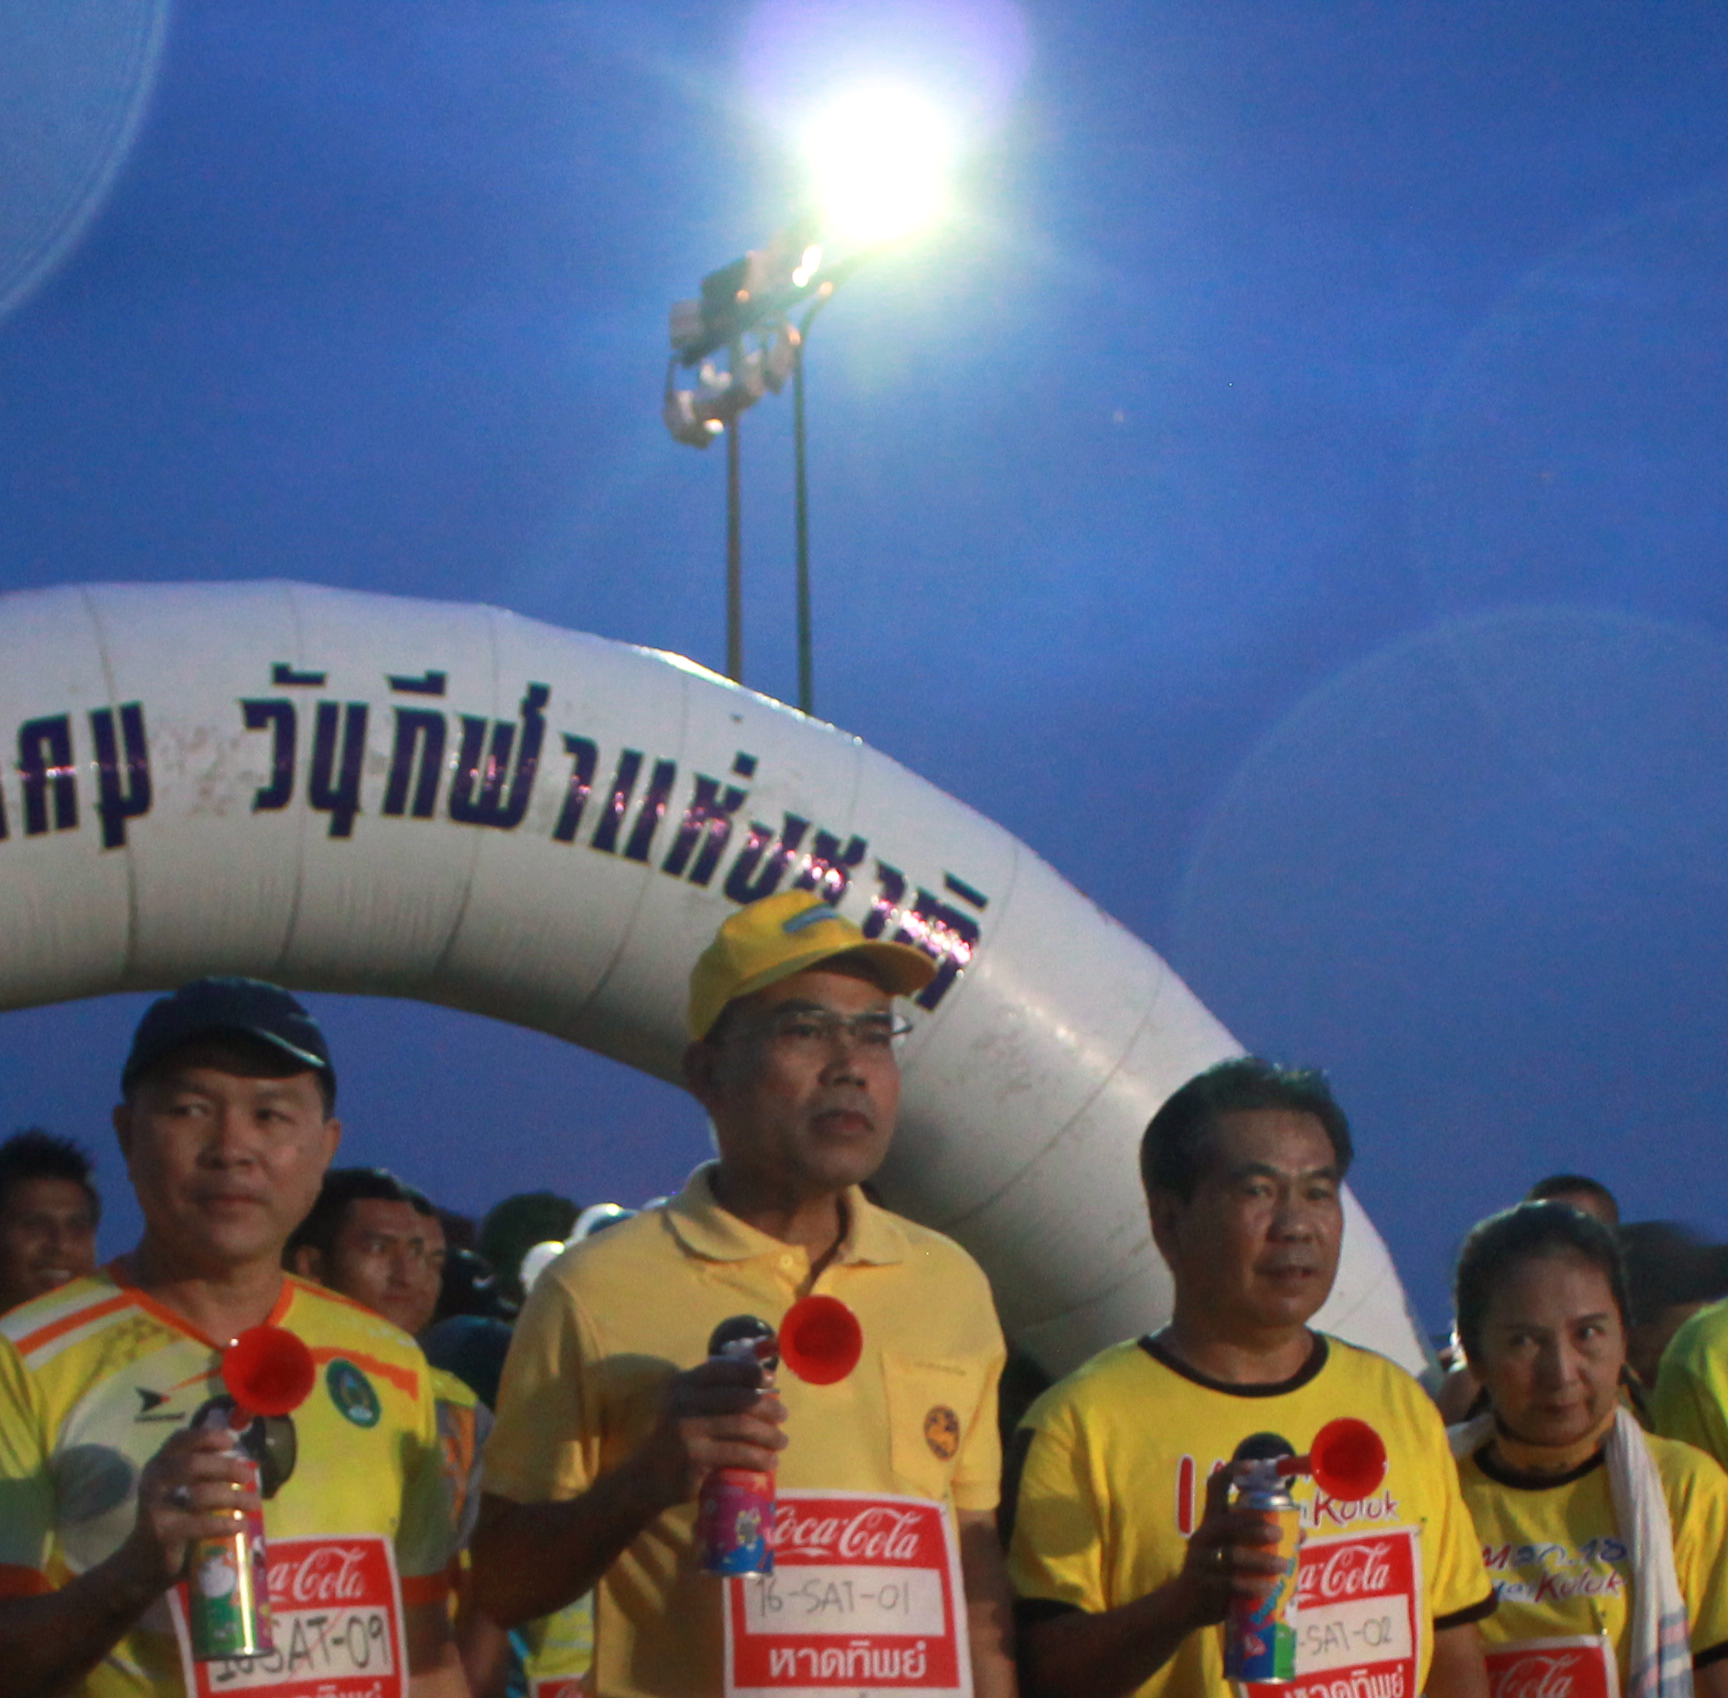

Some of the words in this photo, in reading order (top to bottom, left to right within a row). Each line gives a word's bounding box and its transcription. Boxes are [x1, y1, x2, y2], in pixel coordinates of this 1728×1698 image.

[266, 1546, 369, 1603] a-Cola
[1298, 1542, 1395, 1601] a-Cola
[756, 1577, 911, 1619] 16-SAT-01
[1298, 1615, 1393, 1656] -SAT-02
[767, 1638, 927, 1679] หาดทิพย์
